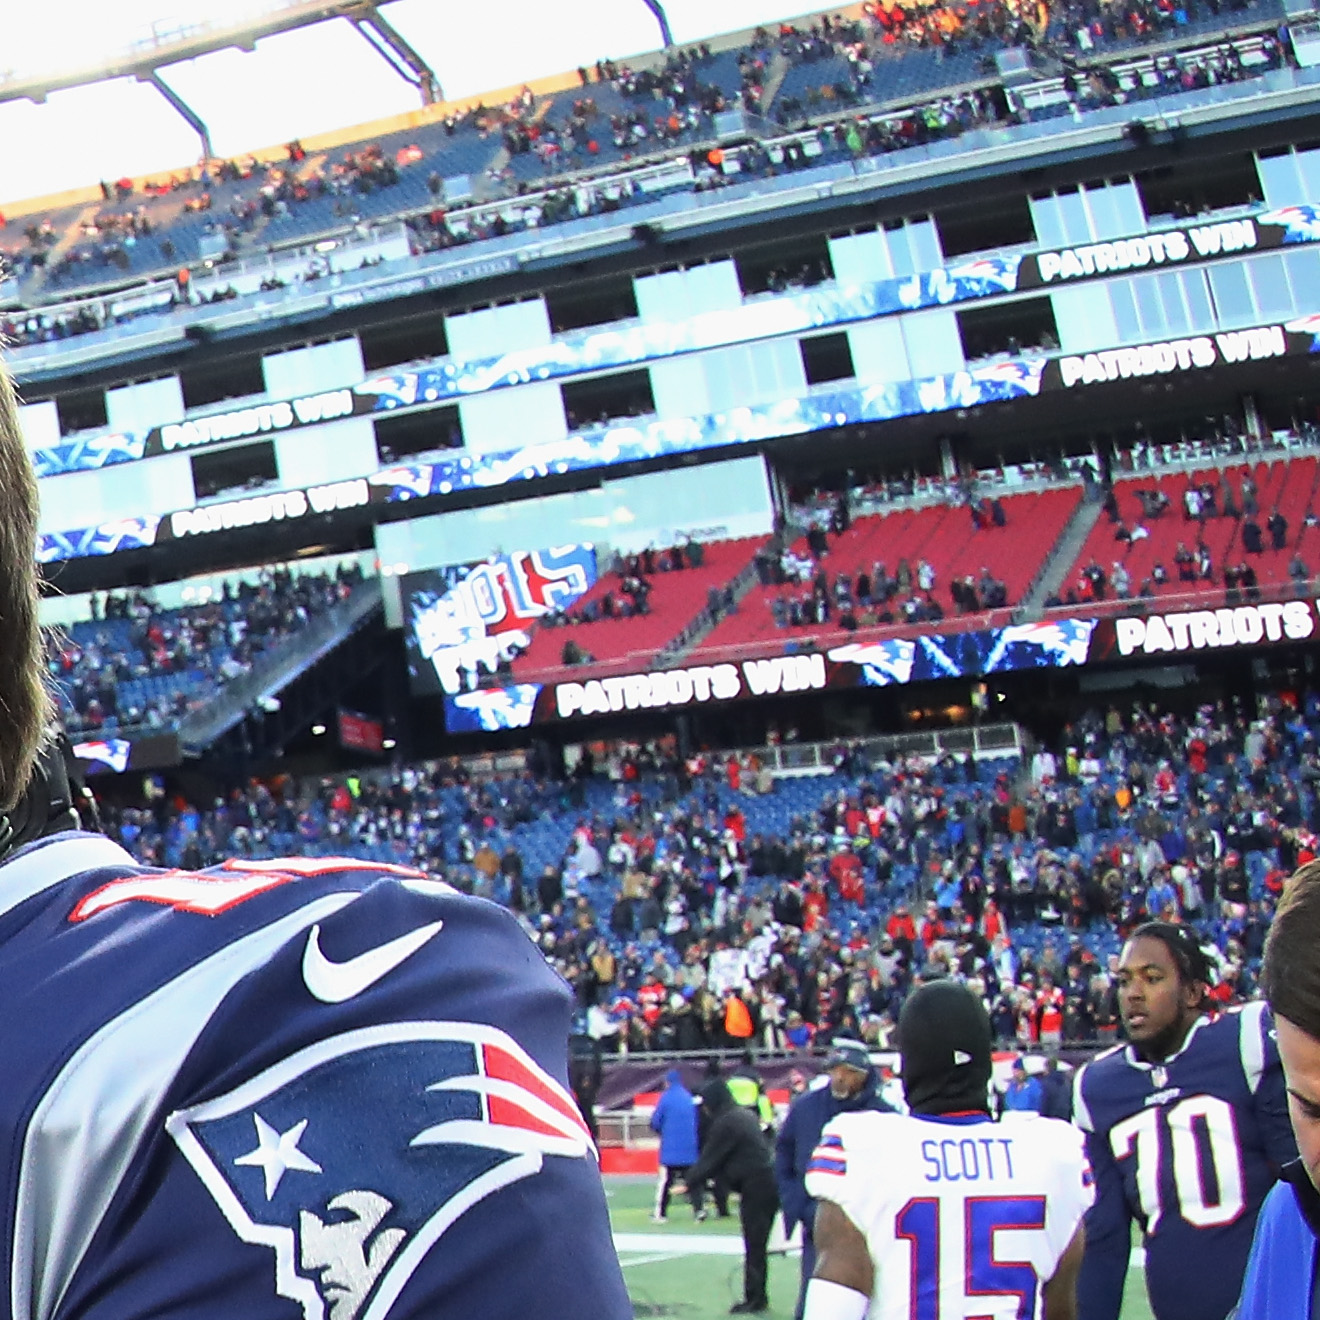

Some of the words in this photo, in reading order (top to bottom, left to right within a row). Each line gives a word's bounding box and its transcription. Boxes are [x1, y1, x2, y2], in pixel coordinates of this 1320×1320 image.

[1037, 232, 1189, 282] PATRIOTS
[1189, 220, 1257, 255] WIN
[1060, 337, 1216, 388] PATRIOTS
[1216, 326, 1286, 362] WIN
[161, 402, 293, 450] PATRIOTS
[293, 389, 353, 423] WIN
[171, 491, 308, 538] PATRIOTS
[307, 479, 368, 513] WIN
[1116, 601, 1314, 656] PATRIOTS
[556, 664, 741, 717] PATRIOTS
[742, 654, 826, 695] WIN
[921, 1138, 1014, 1182] SCOTT
[1109, 1092, 1248, 1237] 70
